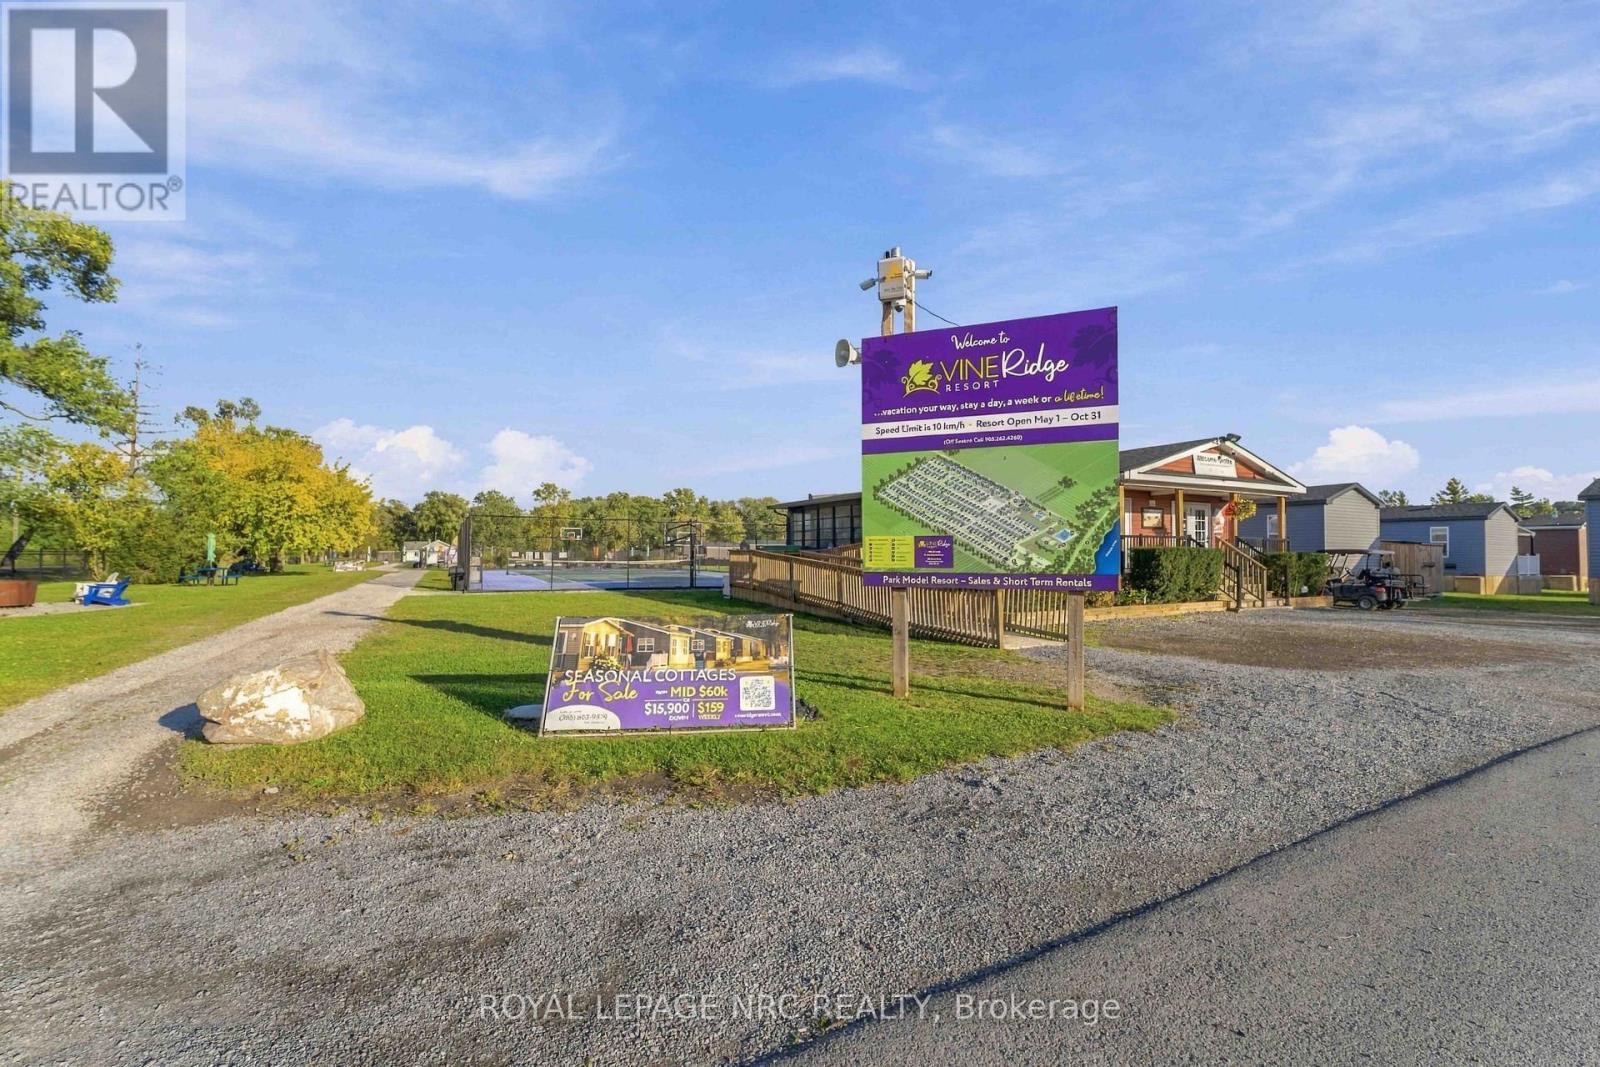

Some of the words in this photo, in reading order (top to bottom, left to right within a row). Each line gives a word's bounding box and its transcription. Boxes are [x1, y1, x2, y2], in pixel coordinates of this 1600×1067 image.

[951, 332, 997, 350] Welcome
[998, 331, 1010, 343] to
[945, 380, 999, 392] RESORT
[918, 405, 938, 414] your
[939, 403, 959, 412] way,
[960, 401, 978, 410] stay
[987, 398, 1006, 408] day,
[1014, 395, 1039, 405] week
[1063, 386, 1104, 402] lifetime!
[875, 425, 900, 436] Speed
[901, 424, 923, 433] Limit
[932, 423, 941, 431] 10
[943, 421, 965, 430] km/h
[976, 418, 1004, 427] Resort
[1007, 416, 1032, 427] Open
[1034, 414, 1053, 424] May
[1056, 414, 1060, 422] 1
[1070, 412, 1089, 421] Oct
[1091, 411, 1101, 420] 31
[883, 575, 901, 584] Park
[902, 576, 929, 584] Model
[931, 576, 959, 584] Resort
[968, 576, 991, 585] Sales
[993, 576, 1000, 585] &
[1003, 576, 1028, 585] Short
[1030, 577, 1053, 586] Term
[1056, 577, 1092, 587] Rentals
[565, 669, 652, 684] SEASONAL
[655, 668, 736, 682] COTTAGES
[562, 679, 595, 702] For
[598, 680, 638, 703] Sale
[670, 686, 696, 698] MID
[699, 685, 728, 698] $60k
[644, 702, 690, 716] $15,900
[697, 701, 724, 714] $159
